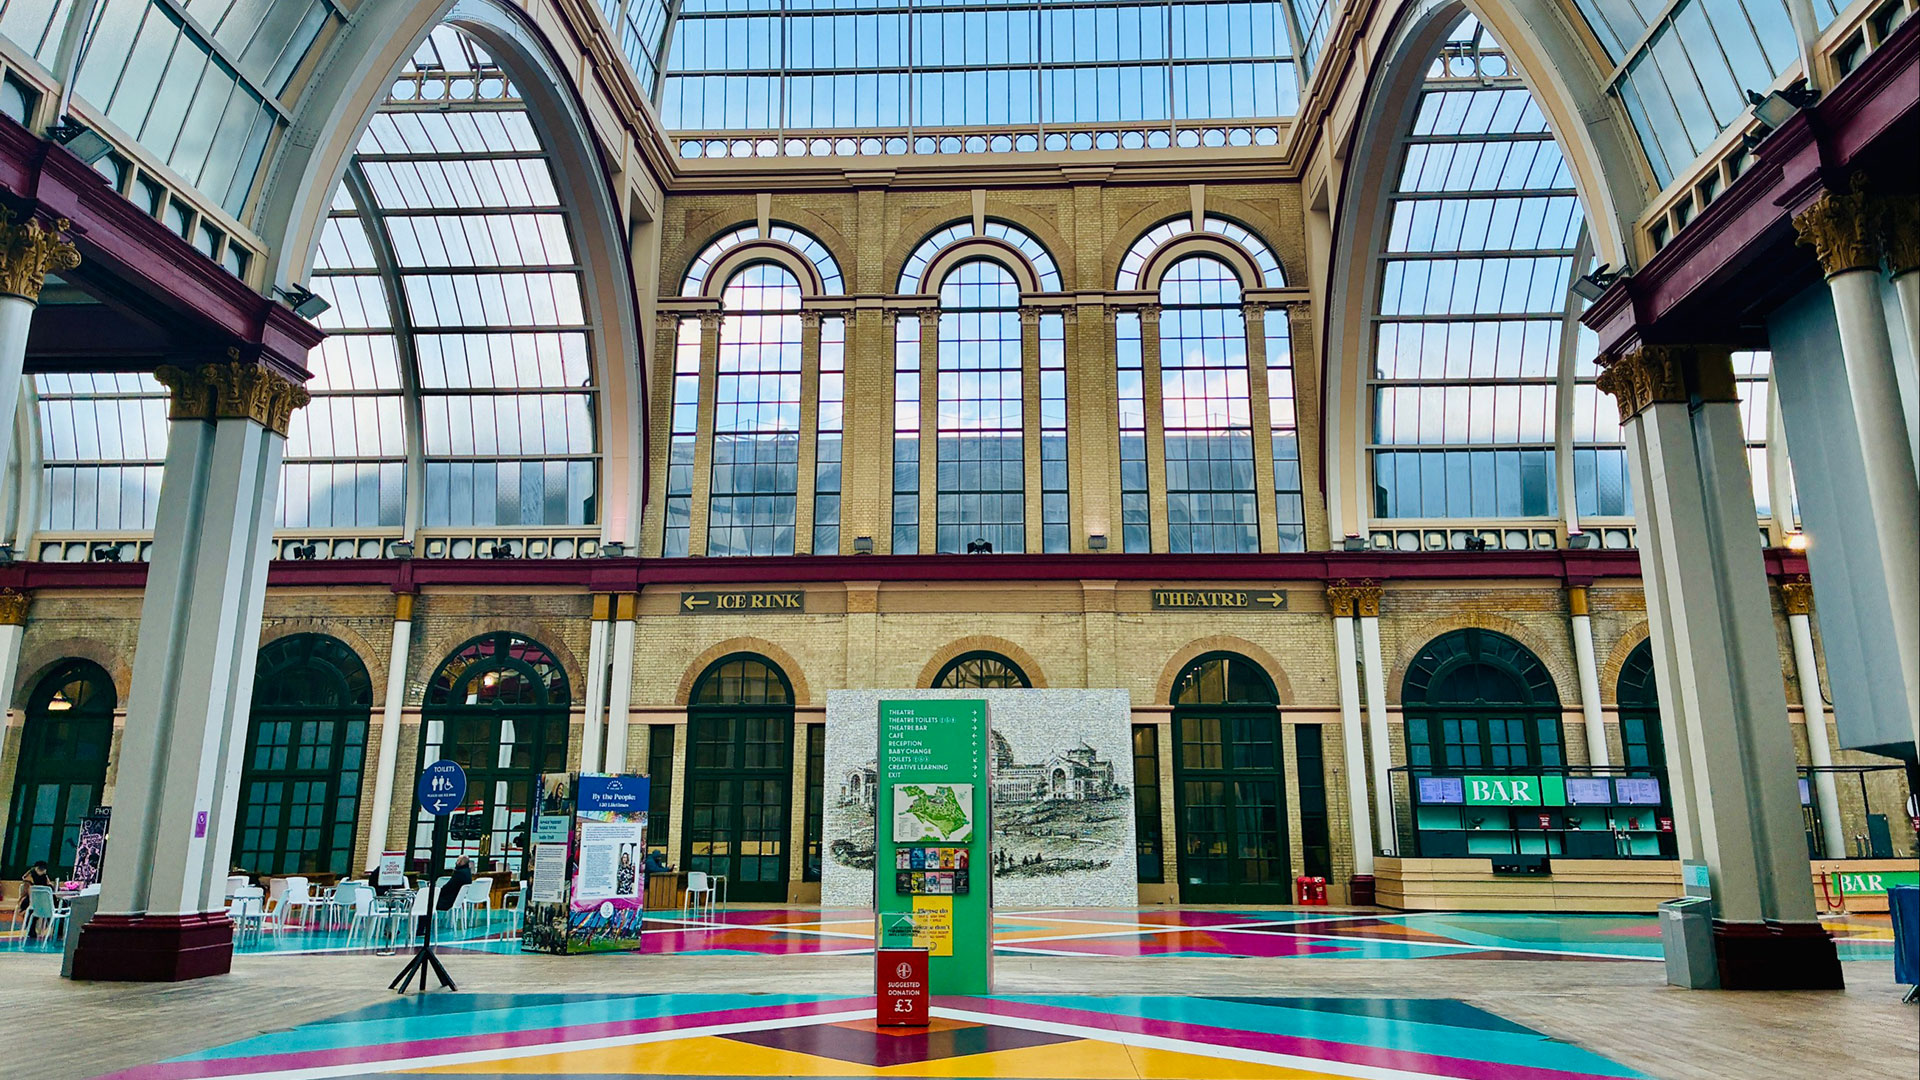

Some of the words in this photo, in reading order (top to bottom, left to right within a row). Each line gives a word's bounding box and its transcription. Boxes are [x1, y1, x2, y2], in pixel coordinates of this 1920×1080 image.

[716, 594, 746, 608] ICE
[750, 594, 800, 608] RINK
[1155, 592, 1248, 607] THEATRE
[434, 765, 455, 773] TOILETS
[592, 793, 600, 802] By
[1471, 780, 1533, 801] BAR
[1840, 874, 1886, 892] BAR
[894, 999, 913, 1012] £3
